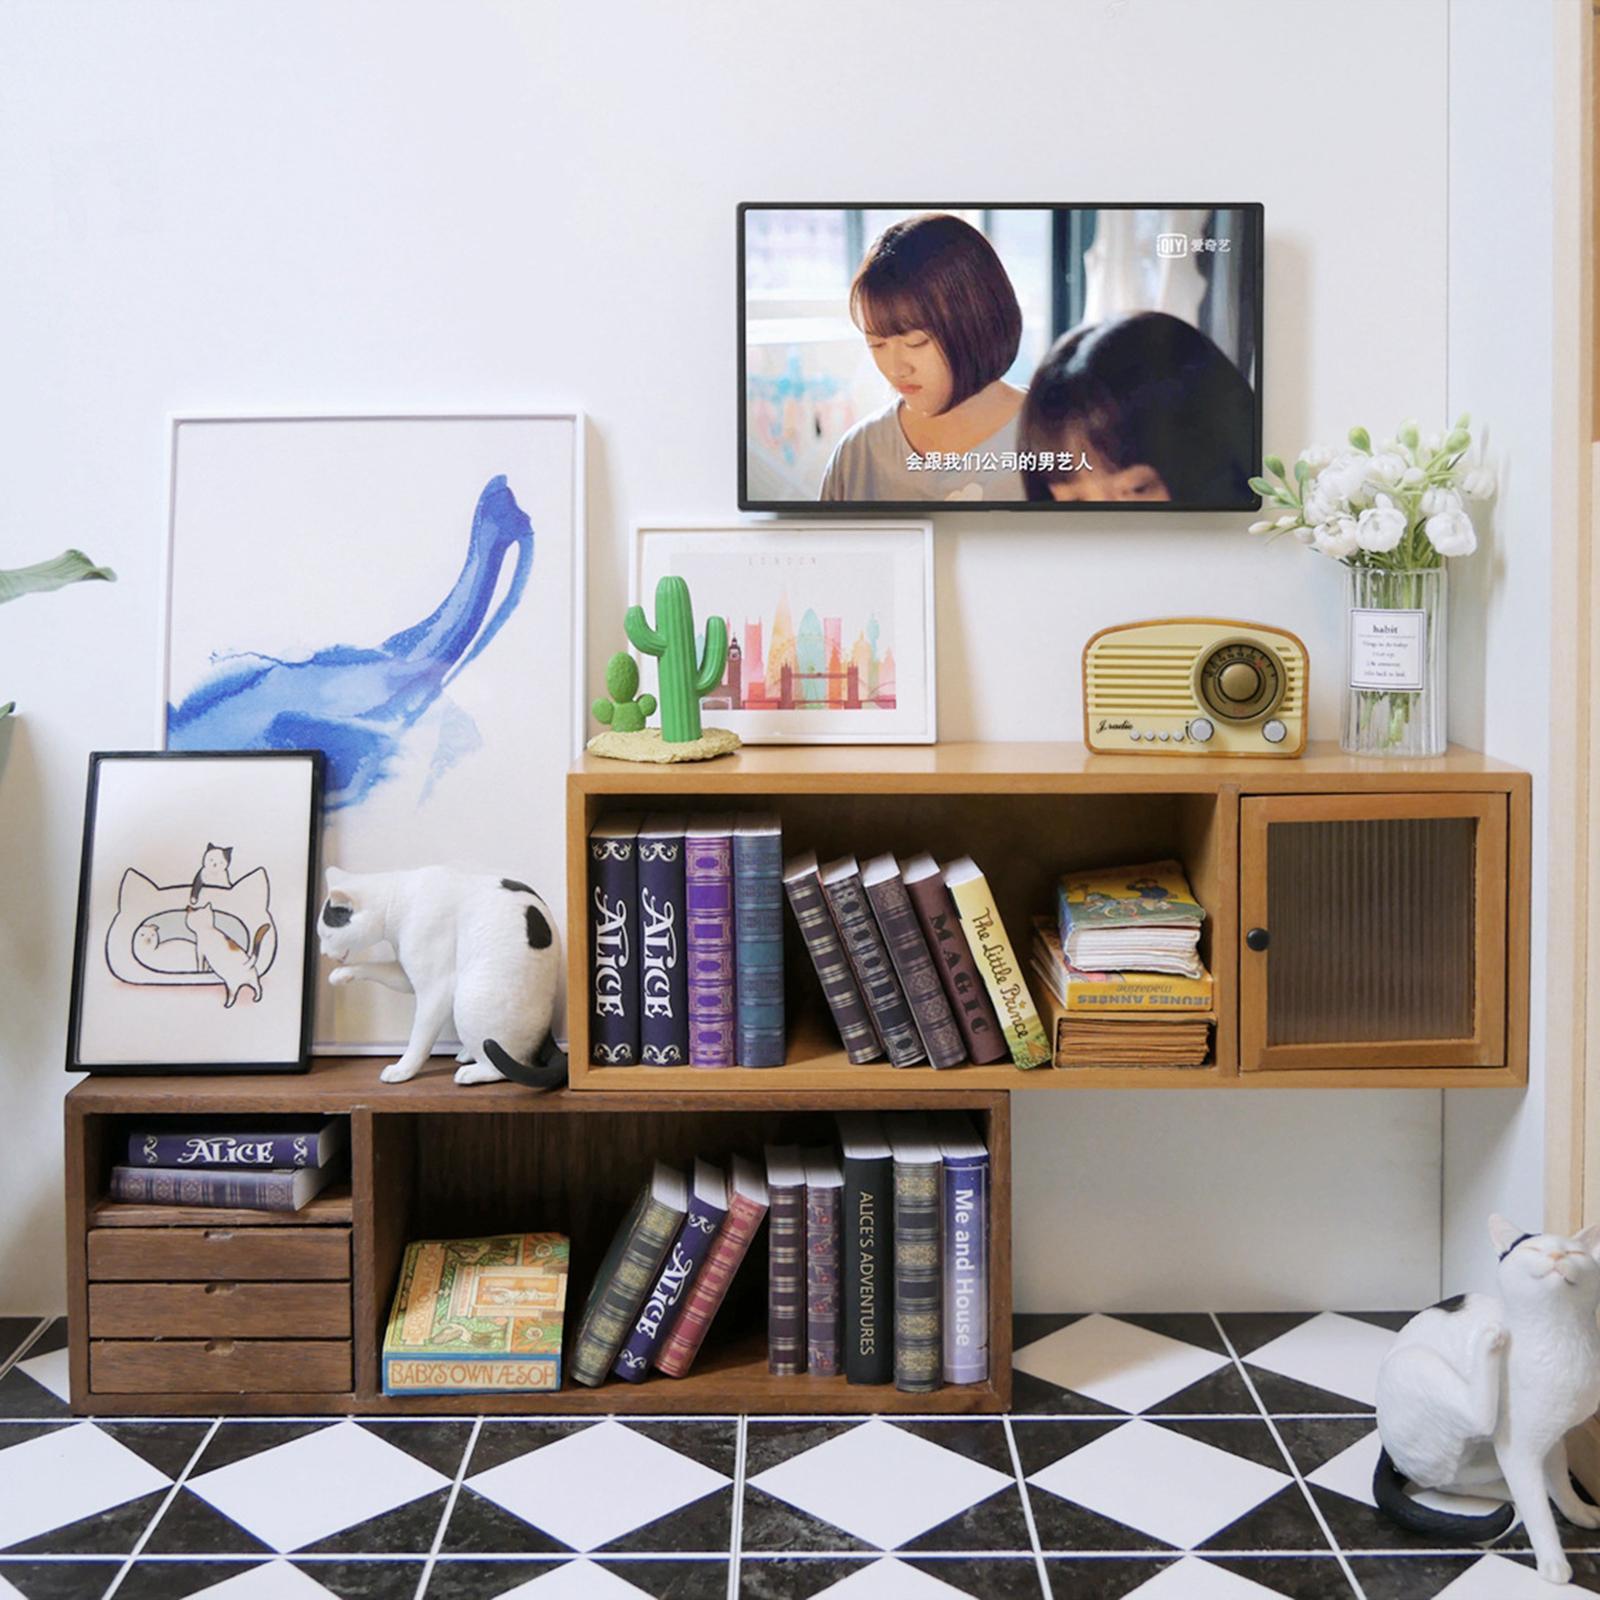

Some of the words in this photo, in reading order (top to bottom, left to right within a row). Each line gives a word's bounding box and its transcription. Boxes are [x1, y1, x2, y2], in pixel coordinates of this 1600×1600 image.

[906, 451, 1093, 472] 会跟我们公司的男艺人
[1372, 625, 1399, 634] habit
[972, 907, 994, 941] The
[928, 912, 989, 1034] MAGIC
[982, 944, 1013, 985] Little
[1000, 983, 1029, 1038] Prince
[859, 1191, 874, 1248] ALICE'S
[955, 1189, 974, 1224] Me
[955, 1230, 975, 1271] and
[859, 1251, 875, 1356] ADVENTURES
[955, 1278, 975, 1347] House
[450, 1364, 494, 1385] OWN
